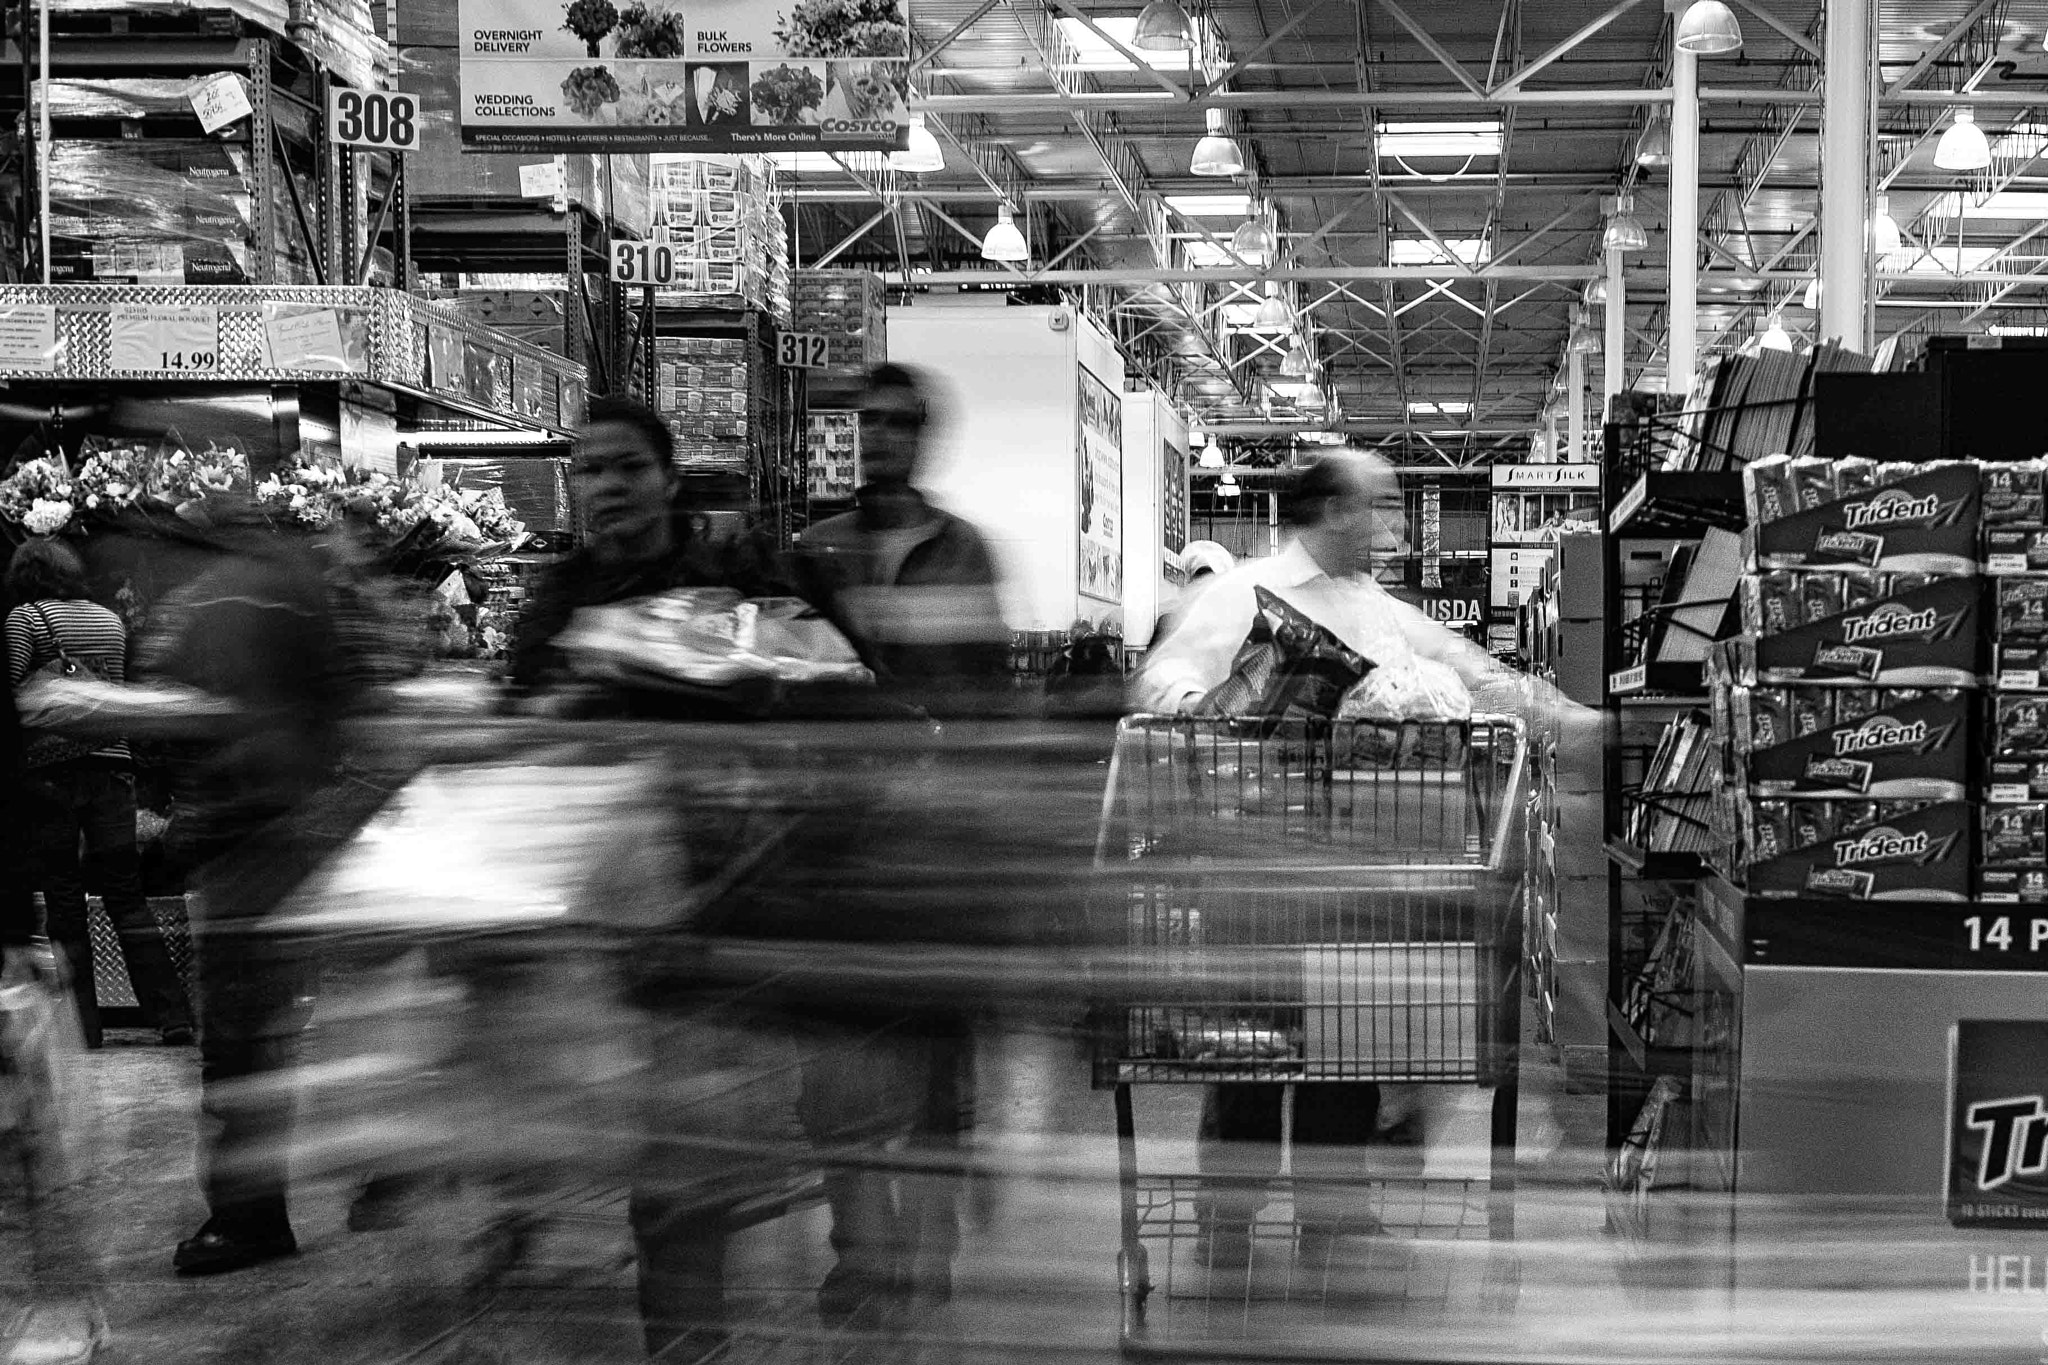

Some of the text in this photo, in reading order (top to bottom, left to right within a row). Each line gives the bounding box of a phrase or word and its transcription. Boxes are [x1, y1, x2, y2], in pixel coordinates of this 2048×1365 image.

[474, 30, 543, 41] OVERNIGHT
[697, 31, 727, 41] BULK
[474, 42, 531, 53] DELIVERY
[697, 42, 752, 53] FLOWERS
[474, 94, 534, 105] WEDDING
[338, 92, 415, 145] 308
[474, 106, 556, 117] COLLECTIONS
[820, 117, 897, 134] COSTCO
[475, 134, 501, 142] SPECIAL
[502, 134, 540, 143] OCCASIONS
[546, 134, 571, 143] HOTELS
[576, 134, 608, 143] CATERERS
[614, 134, 658, 143] RESTAURANTS
[731, 132, 816, 142] There's More Online
[189, 166, 229, 177] Neutrogena
[195, 214, 236, 225] Neutrogena
[191, 262, 232, 273] Neutrogena
[617, 243, 672, 284] 310
[782, 334, 826, 367] 312
[161, 352, 215, 370] 14.99
[1988, 472, 2012, 488] 14
[1843, 493, 1939, 530] Trident
[1423, 599, 1482, 621] USDA
[2021, 600, 2044, 615] 14
[1841, 606, 1937, 643] Trident
[2016, 707, 2040, 722] 14
[1832, 719, 1927, 756] Trident
[2000, 815, 2024, 829] 14
[1833, 830, 1929, 867] Trident
[2026, 872, 2044, 884] 14
[1963, 916, 2013, 951] 14
